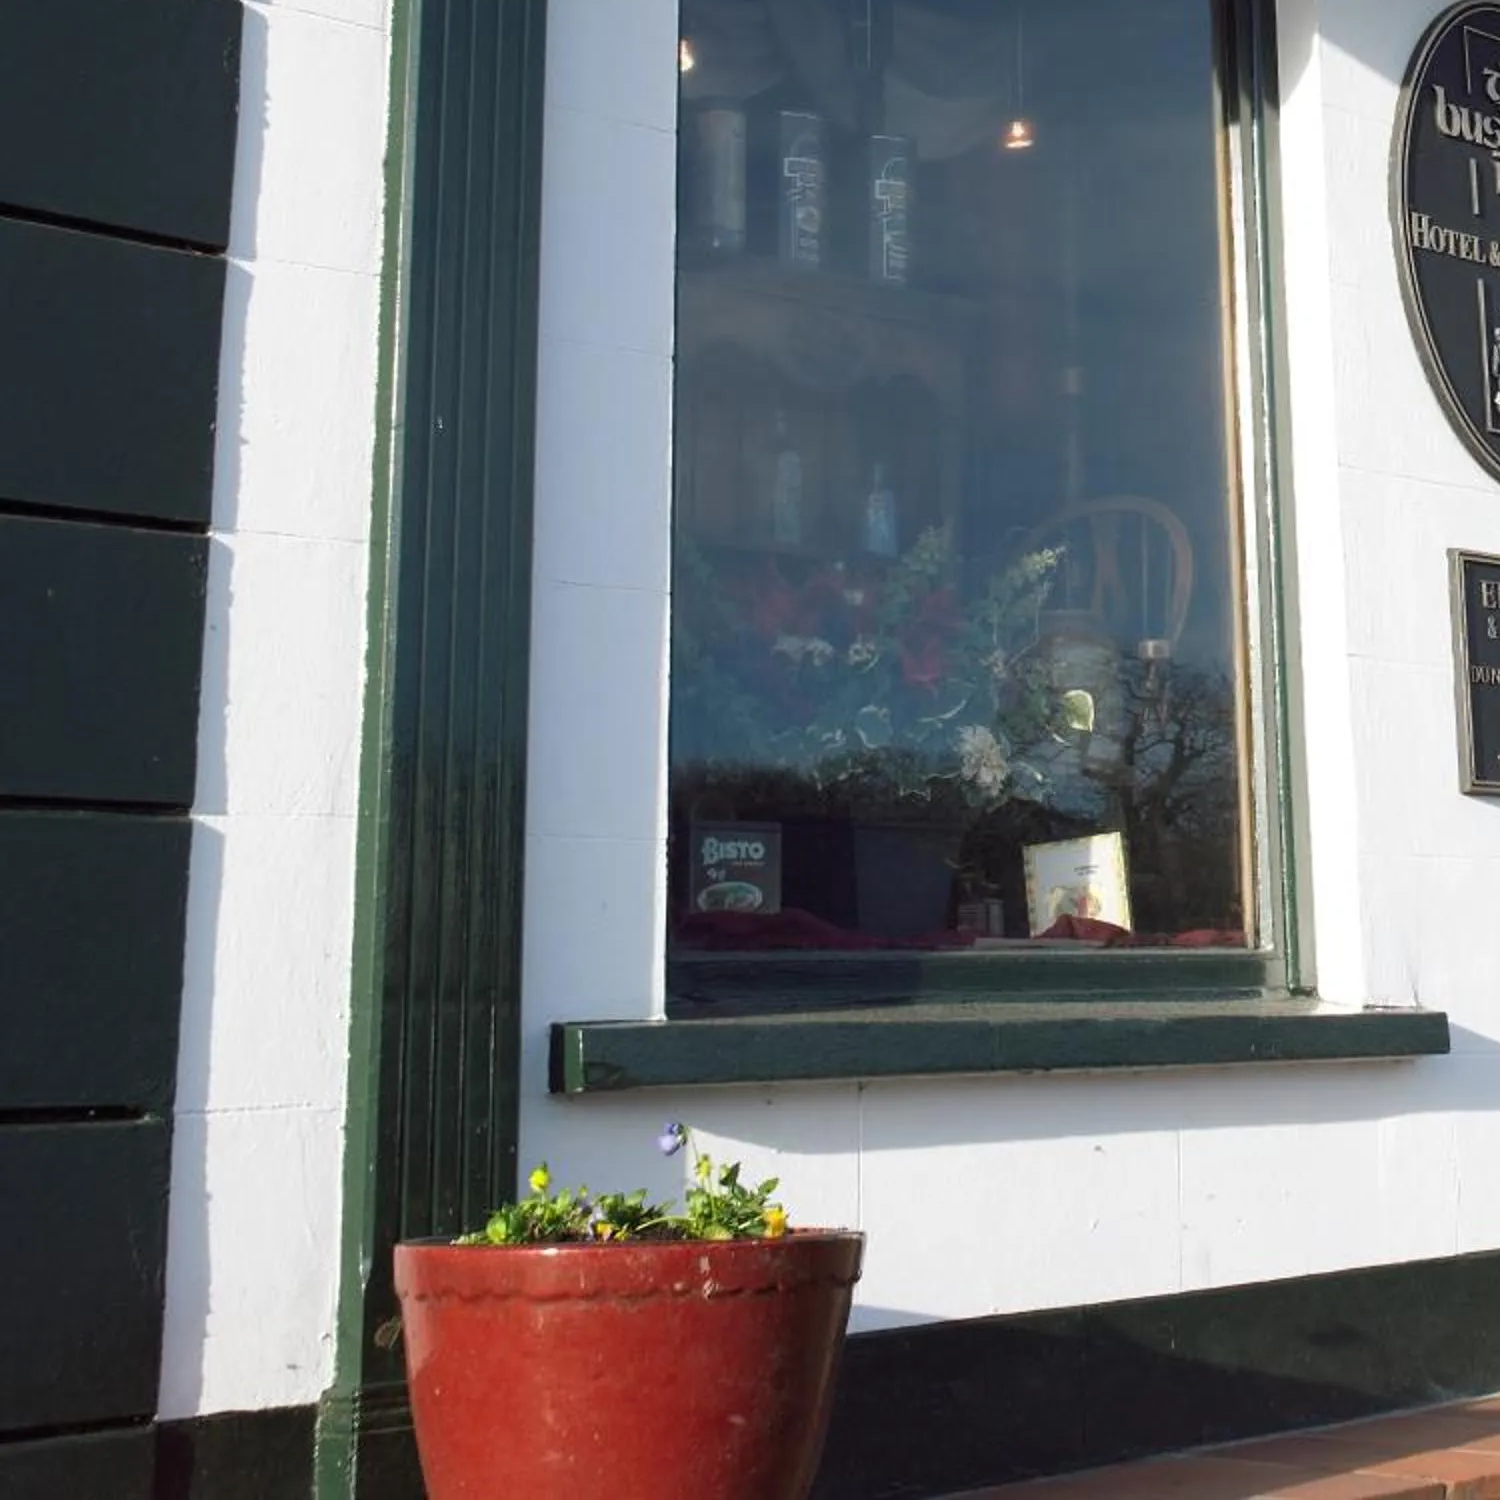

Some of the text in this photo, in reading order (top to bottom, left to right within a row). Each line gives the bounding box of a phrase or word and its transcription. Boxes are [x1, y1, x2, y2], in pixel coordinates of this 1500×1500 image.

[1411, 211, 1487, 263] HOTEL
[1487, 615, 1498, 639] &
[702, 837, 765, 865] BISTO
